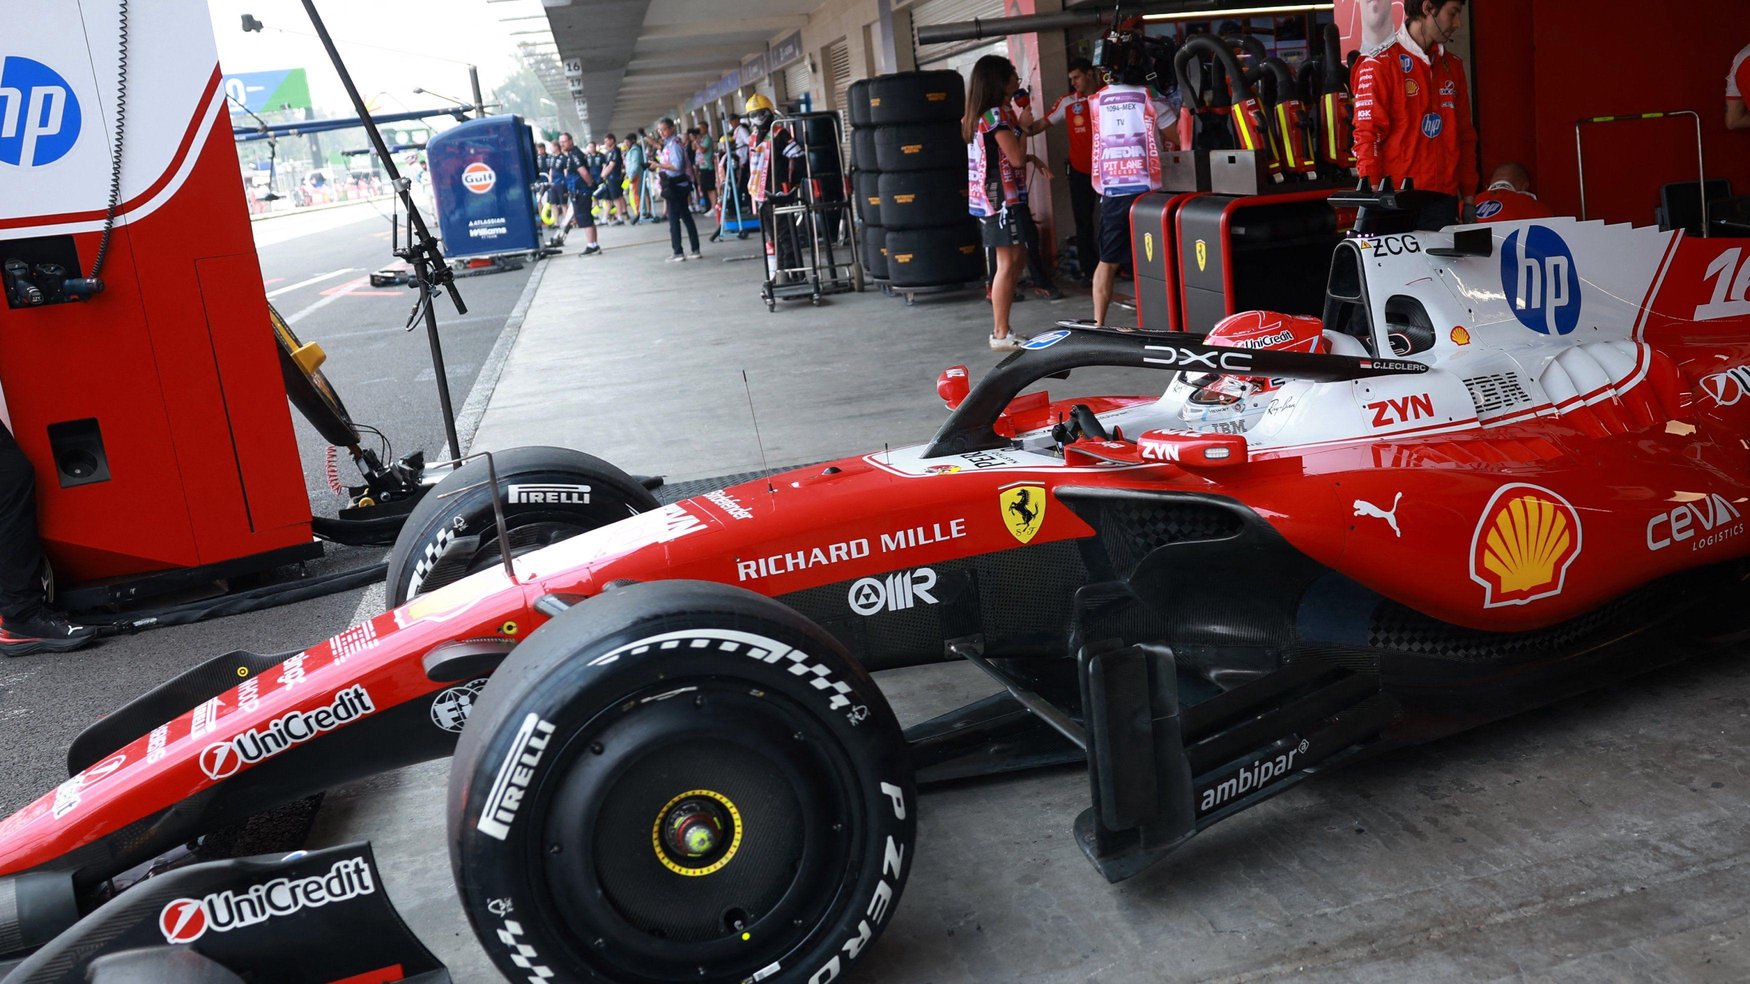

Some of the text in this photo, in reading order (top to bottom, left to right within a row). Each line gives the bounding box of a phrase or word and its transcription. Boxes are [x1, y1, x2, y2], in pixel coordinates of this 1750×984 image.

[565, 62, 580, 72] 16
[1424, 114, 1441, 138] hp
[1101, 146, 1146, 159] MEDIA
[1103, 160, 1144, 171] PIT LANE
[464, 173, 493, 183] Gulf
[1476, 200, 1500, 217] hp
[469, 227, 507, 237] Williams
[473, 217, 506, 226] ATLASSIAN
[1368, 235, 1421, 257] ZCG
[1514, 224, 1570, 336] hp
[1245, 331, 1293, 348] UniCredit
[1143, 345, 1252, 372] DXC
[1373, 361, 1426, 372] C.LECLERC
[1367, 393, 1435, 428] ZYN
[1212, 419, 1248, 435] IBM
[1142, 442, 1180, 462] ZYN
[508, 484, 591, 505] PIRELLI
[1692, 523, 1744, 551] LOGISTICS
[737, 518, 966, 582] RICHARD MILLE
[238, 686, 373, 762] UniCredit
[477, 712, 557, 842] PIRELLI
[1200, 748, 1298, 812] ambipar
[808, 781, 906, 984] P ZERO
[205, 858, 373, 930] UniCredit
